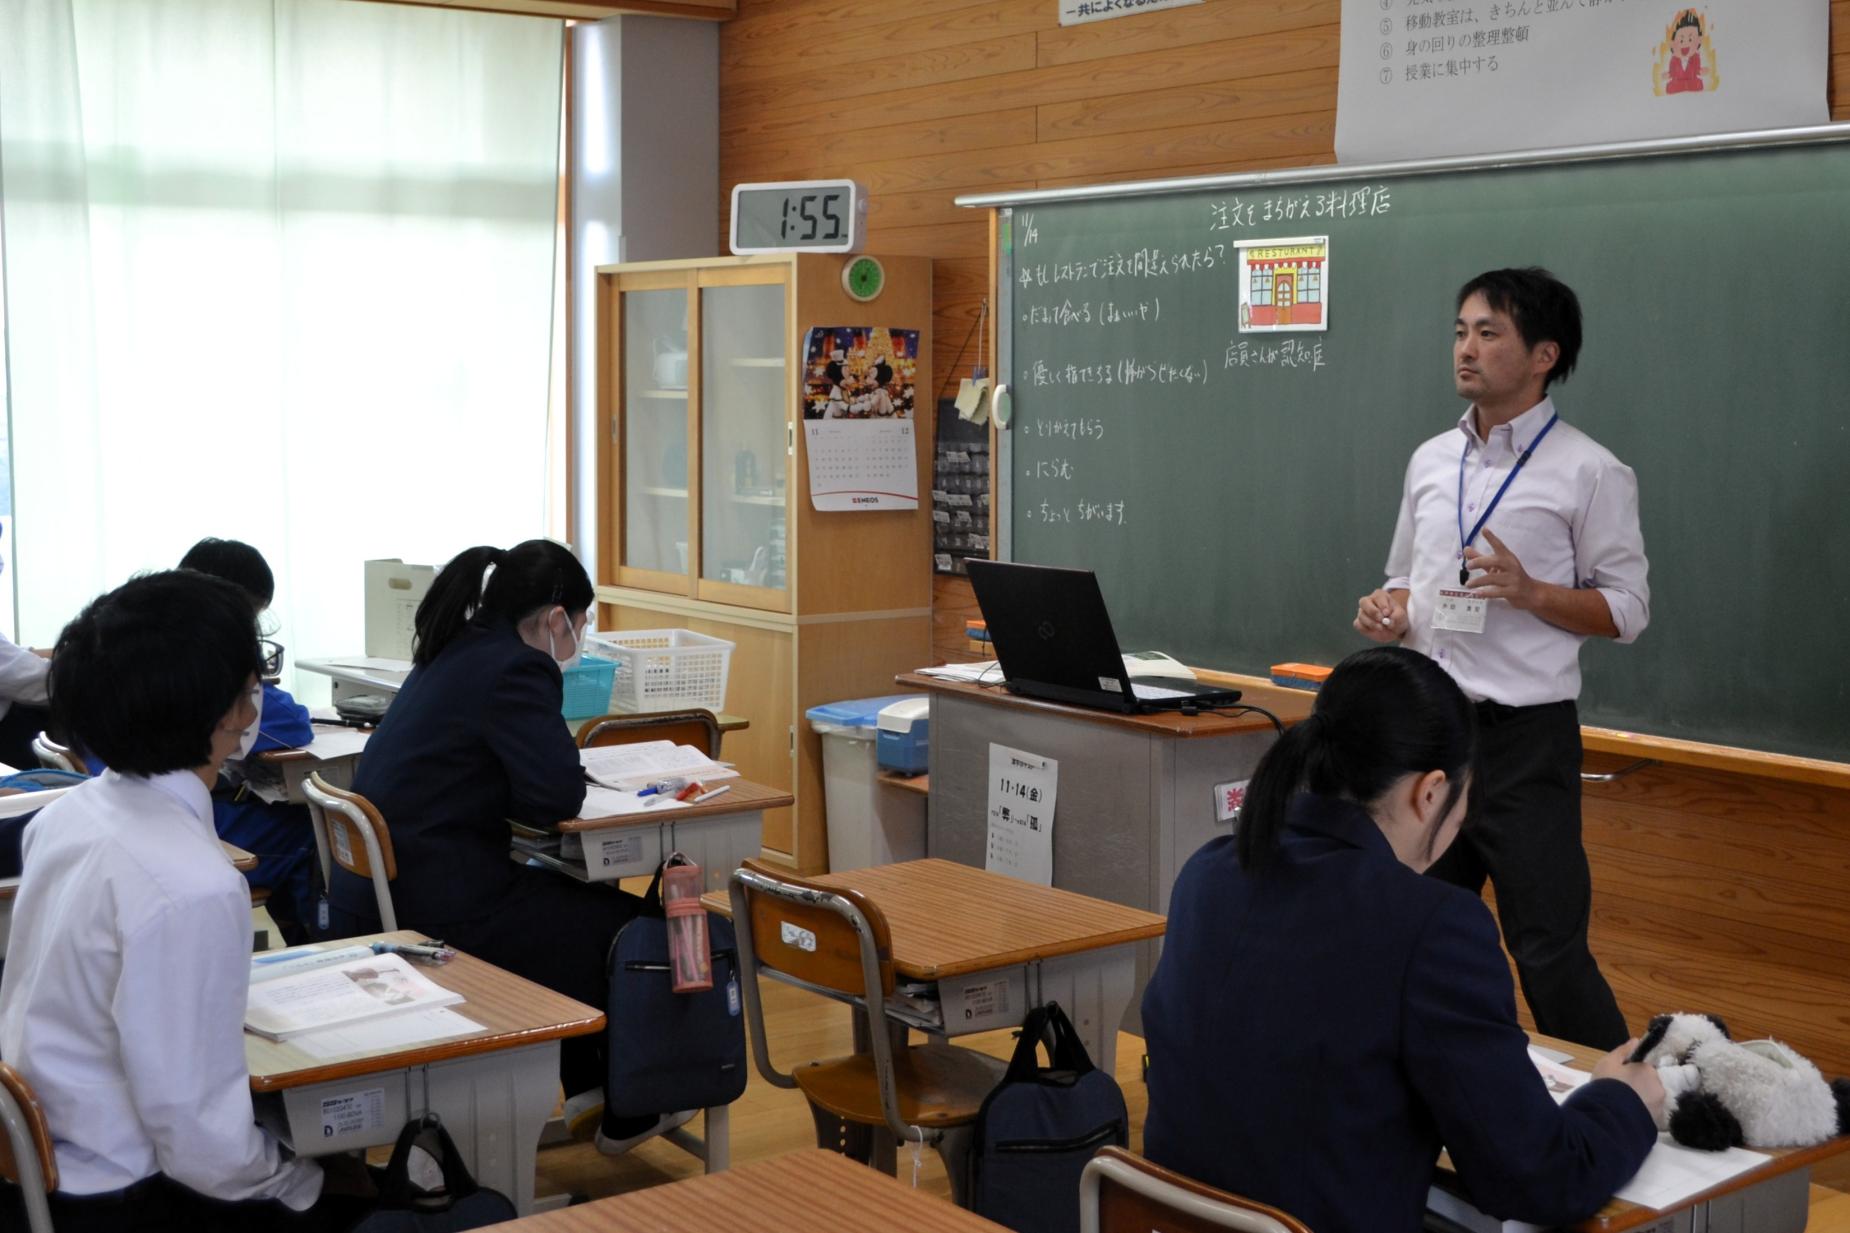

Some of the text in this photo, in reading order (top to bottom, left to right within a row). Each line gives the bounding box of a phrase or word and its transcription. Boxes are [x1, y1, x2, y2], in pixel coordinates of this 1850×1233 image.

[1405, 25, 1530, 56] 身の回りの整理整頓
[1405, 55, 1499, 82] 授業に集中する
[780, 194, 841, 240] 1:55
[324, 1125, 334, 1137] D
